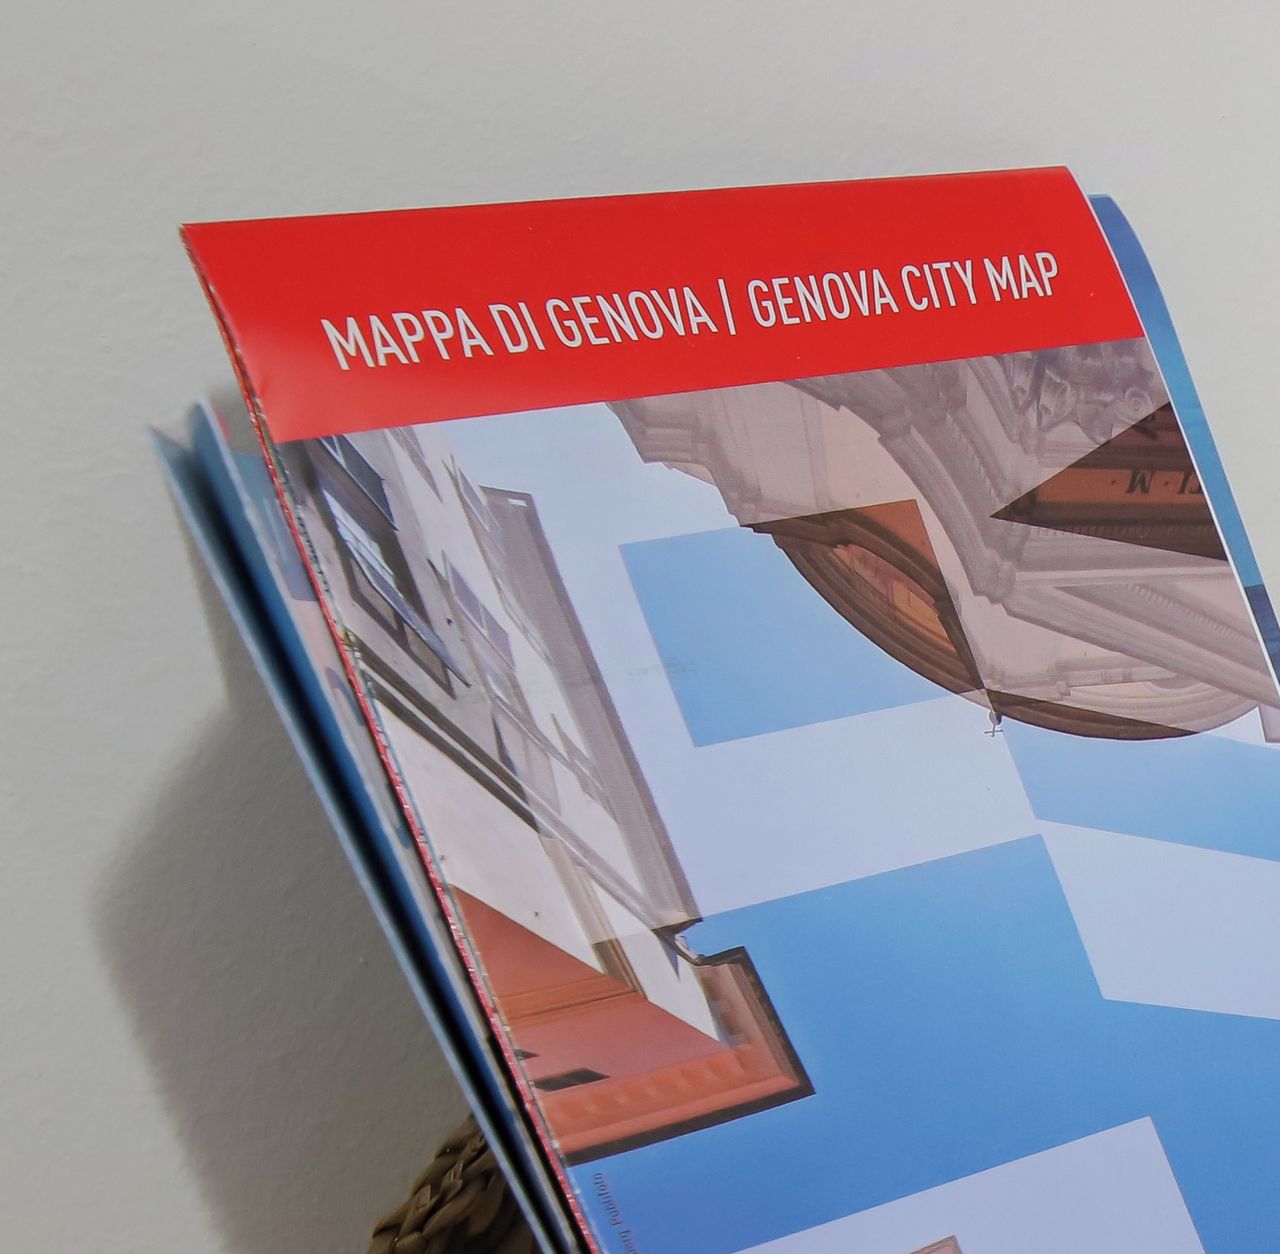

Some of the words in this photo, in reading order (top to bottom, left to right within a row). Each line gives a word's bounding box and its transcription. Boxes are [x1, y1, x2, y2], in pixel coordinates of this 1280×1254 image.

[320, 307, 495, 371] MAPPA
[488, 302, 546, 353] DI
[545, 287, 719, 349] GENOVA
[748, 269, 899, 327] GENOVA
[901, 260, 977, 311] CITY
[984, 252, 1058, 302] MAP
